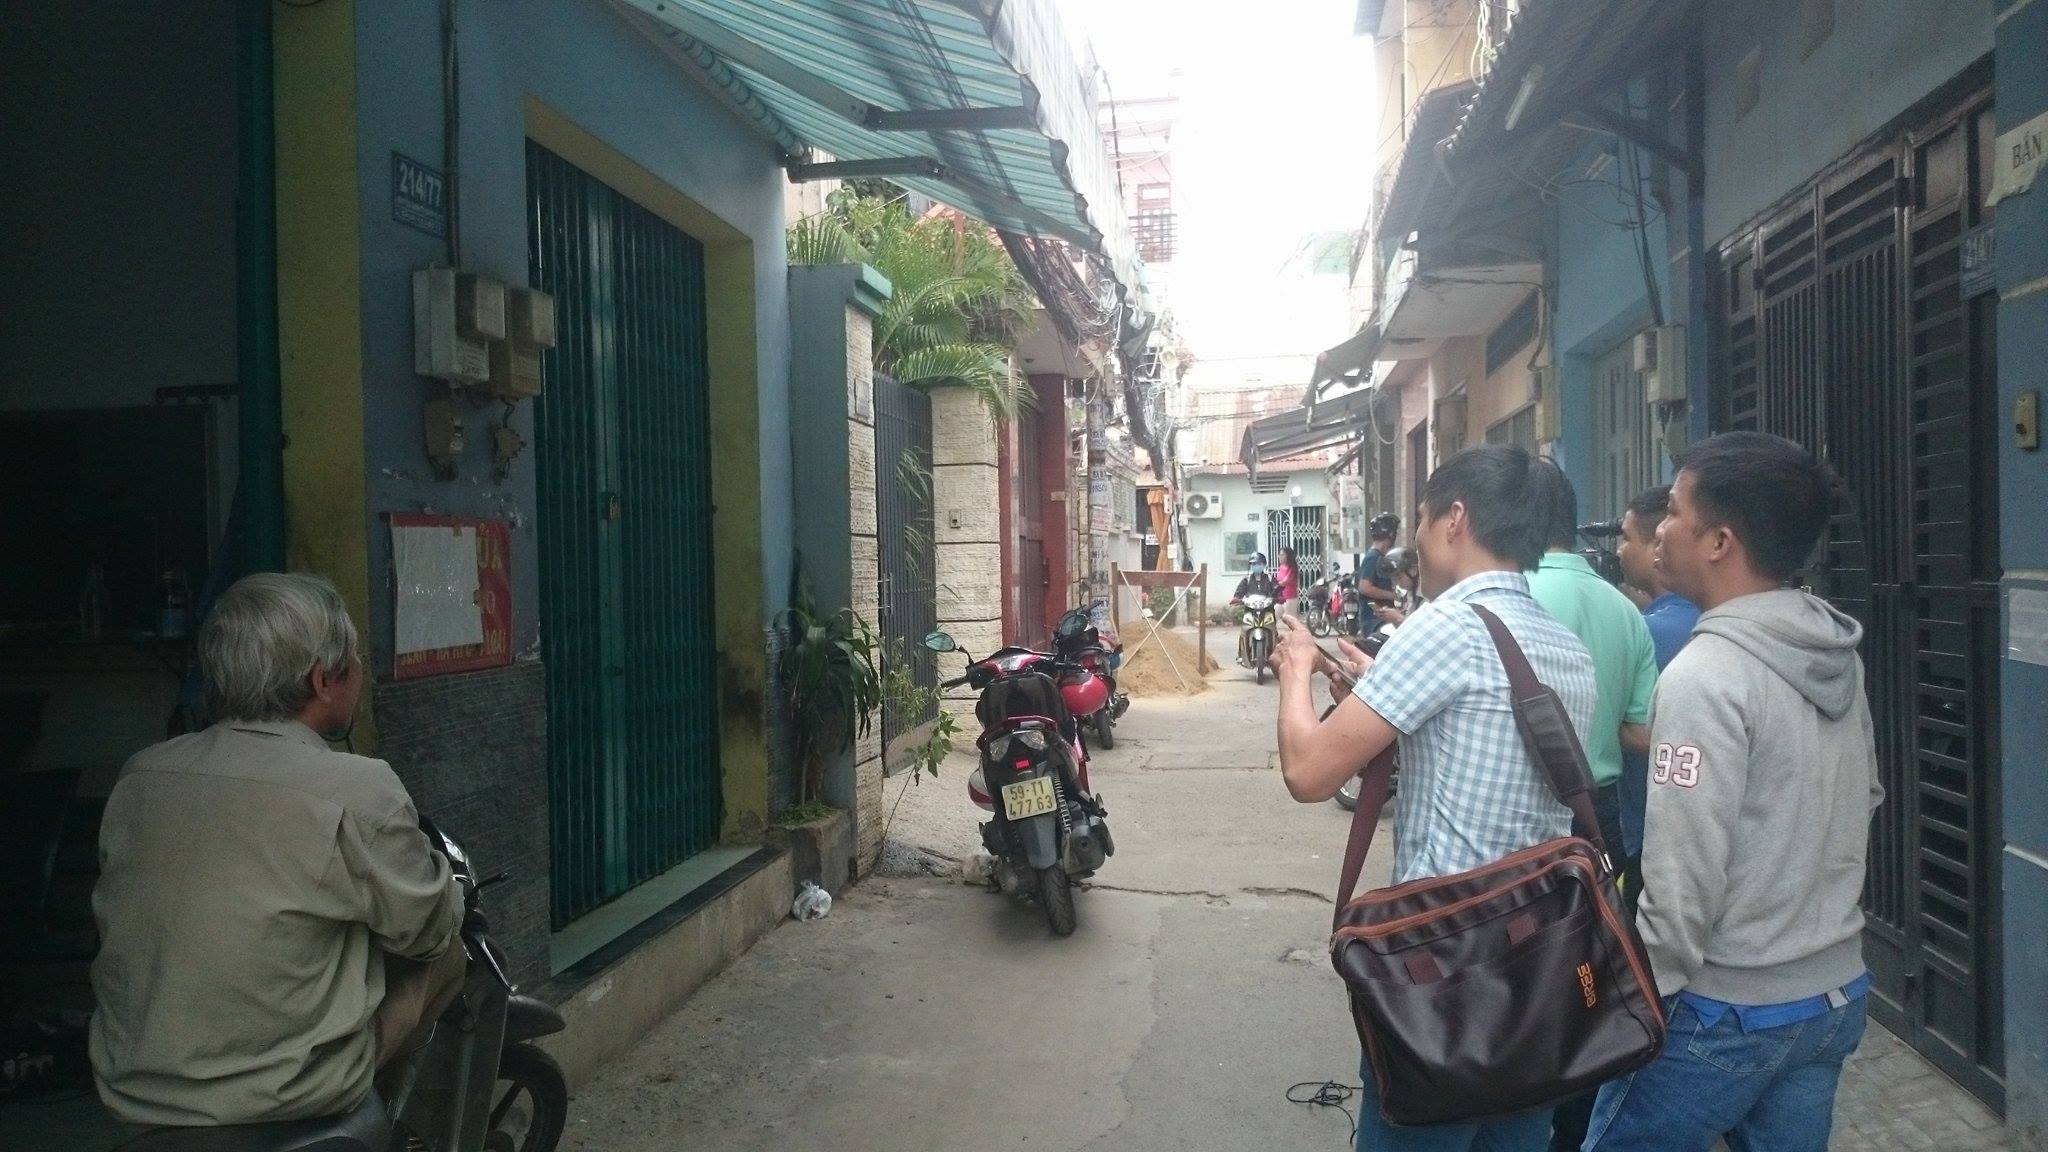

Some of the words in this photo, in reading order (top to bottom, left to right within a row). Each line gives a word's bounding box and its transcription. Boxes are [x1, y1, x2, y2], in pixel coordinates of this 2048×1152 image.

[2011, 131, 2042, 170] BÁN
[1653, 743, 1702, 788] 93
[1009, 780, 1045, 801] 59-T1
